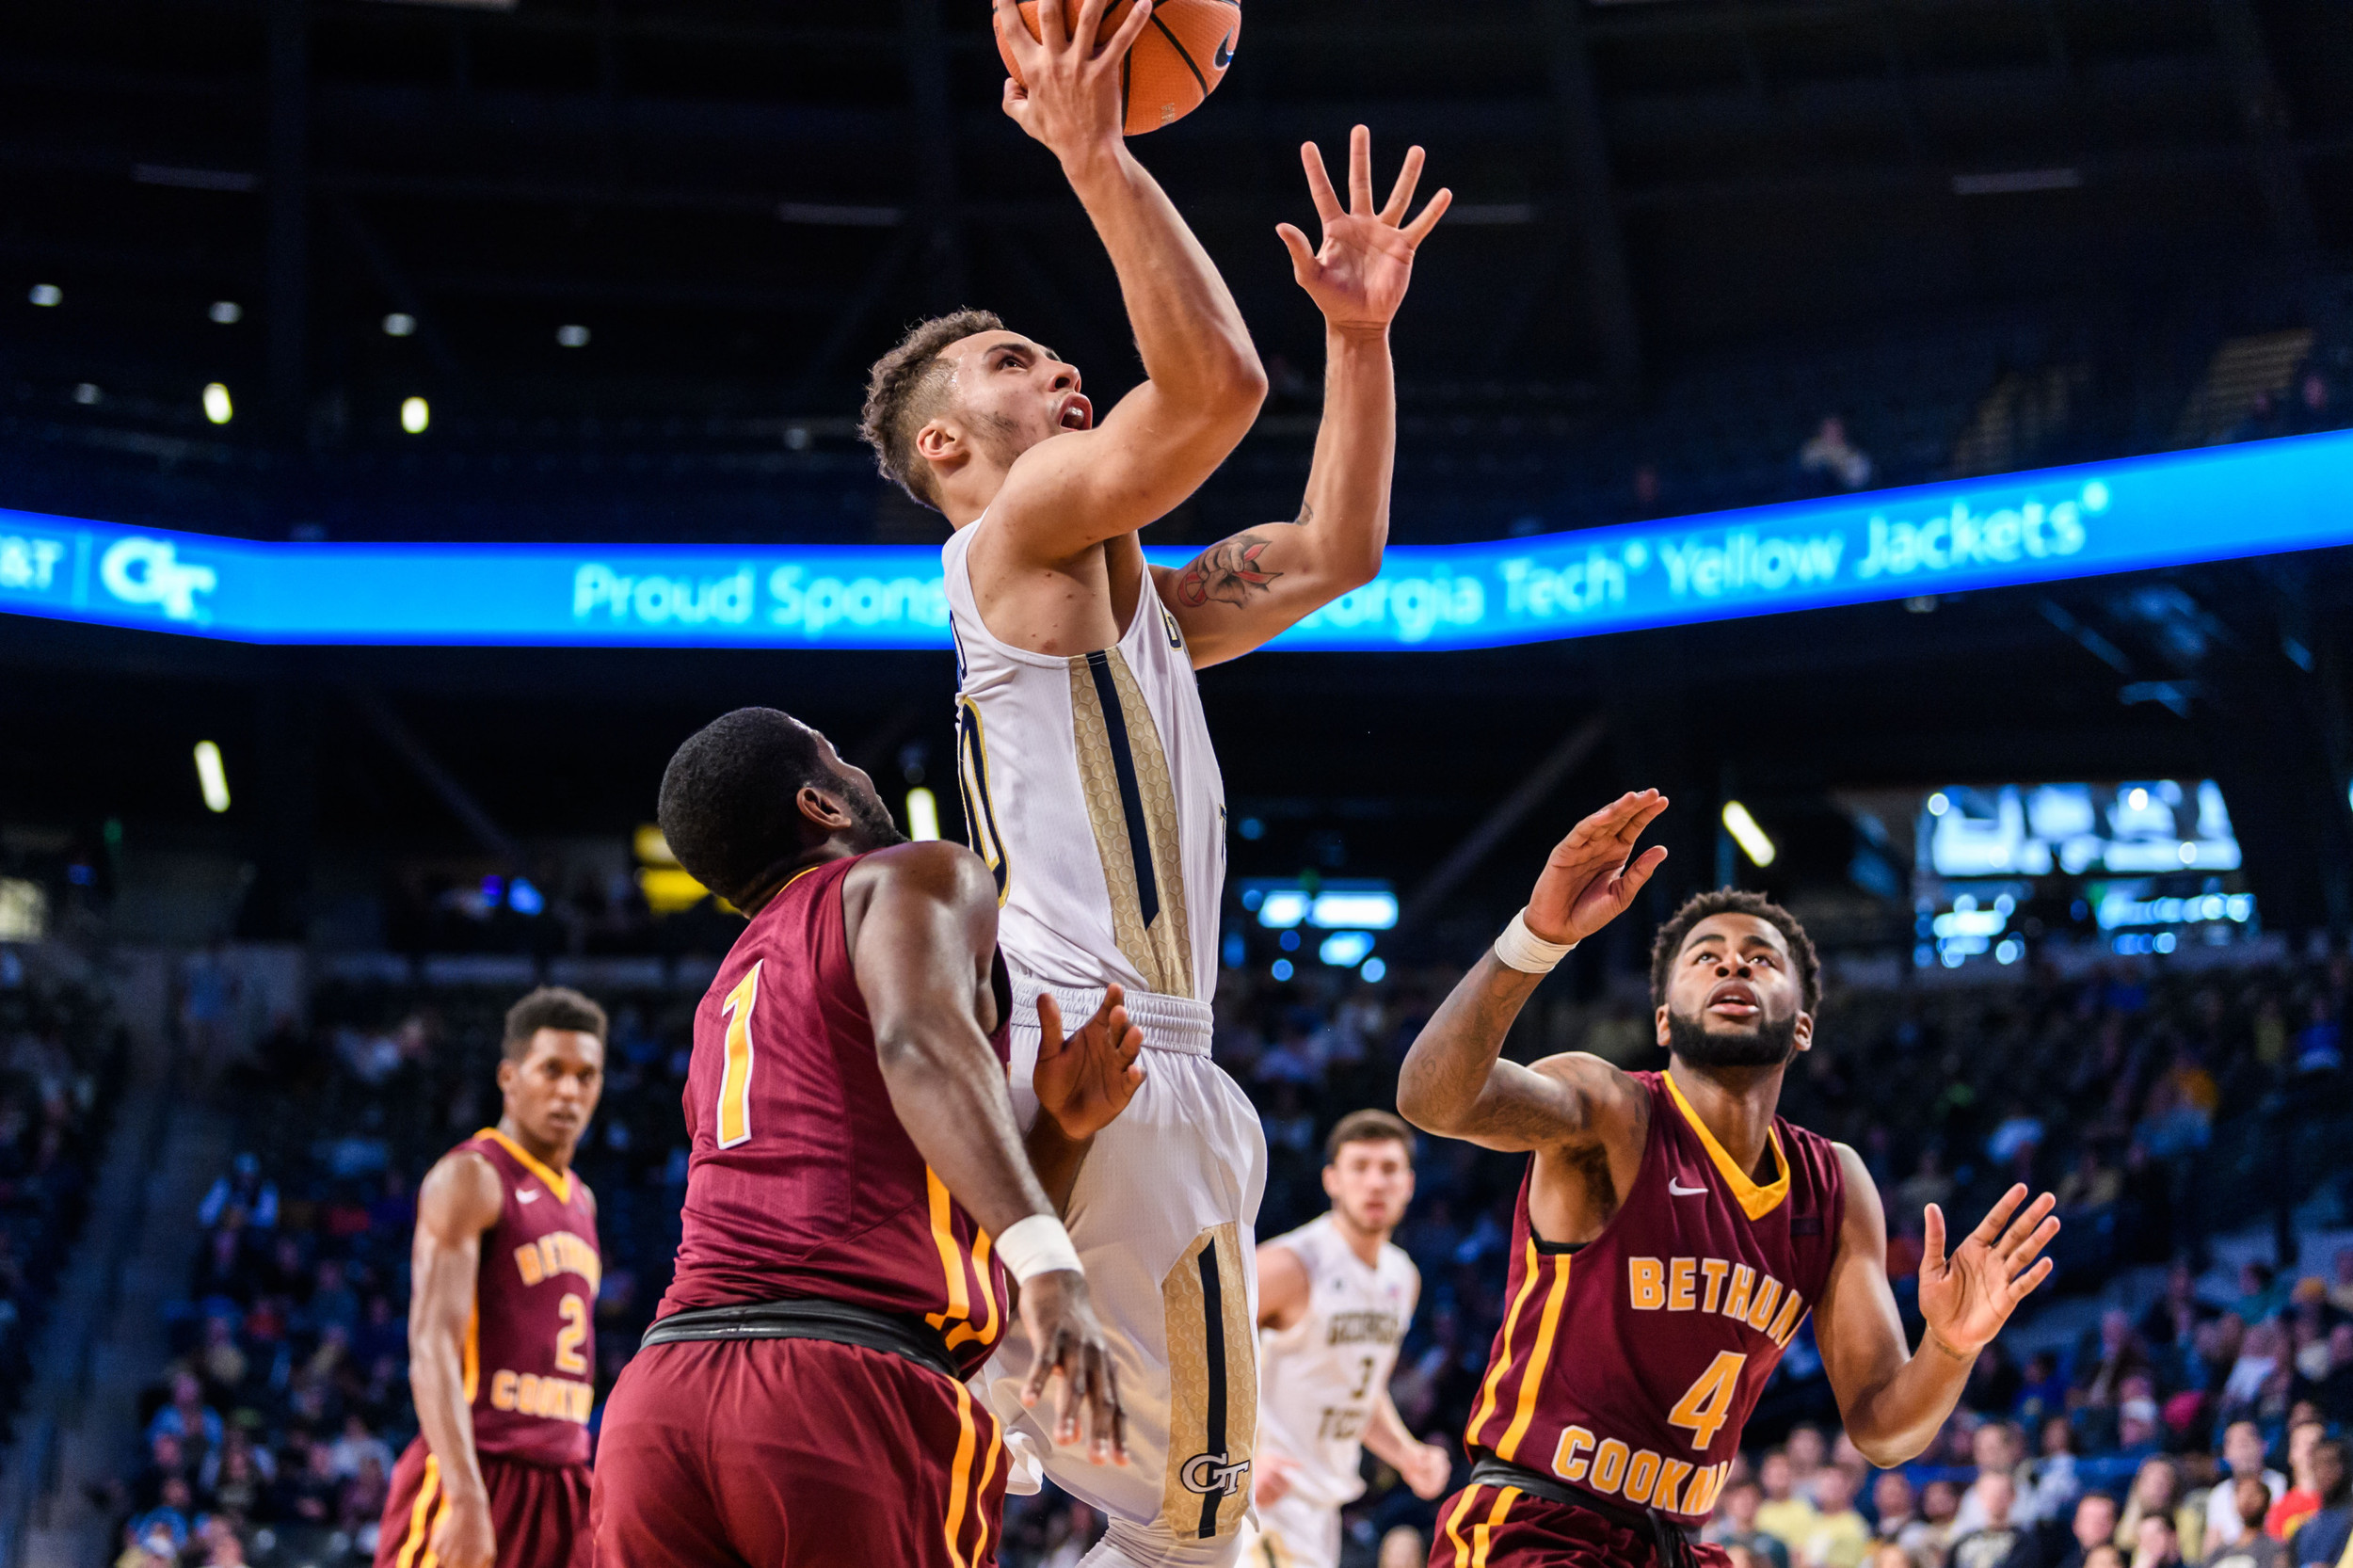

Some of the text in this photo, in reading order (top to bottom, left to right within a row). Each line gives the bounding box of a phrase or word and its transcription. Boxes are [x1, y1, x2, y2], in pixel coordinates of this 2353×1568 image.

[572, 562, 756, 625] Proud
[1295, 563, 1485, 643] orgia
[1659, 527, 1843, 602] Yellow
[716, 958, 764, 1150] 1
[554, 1293, 588, 1375] 2
[1667, 1350, 1748, 1450] 4
[1179, 1450, 1251, 1497] GT
